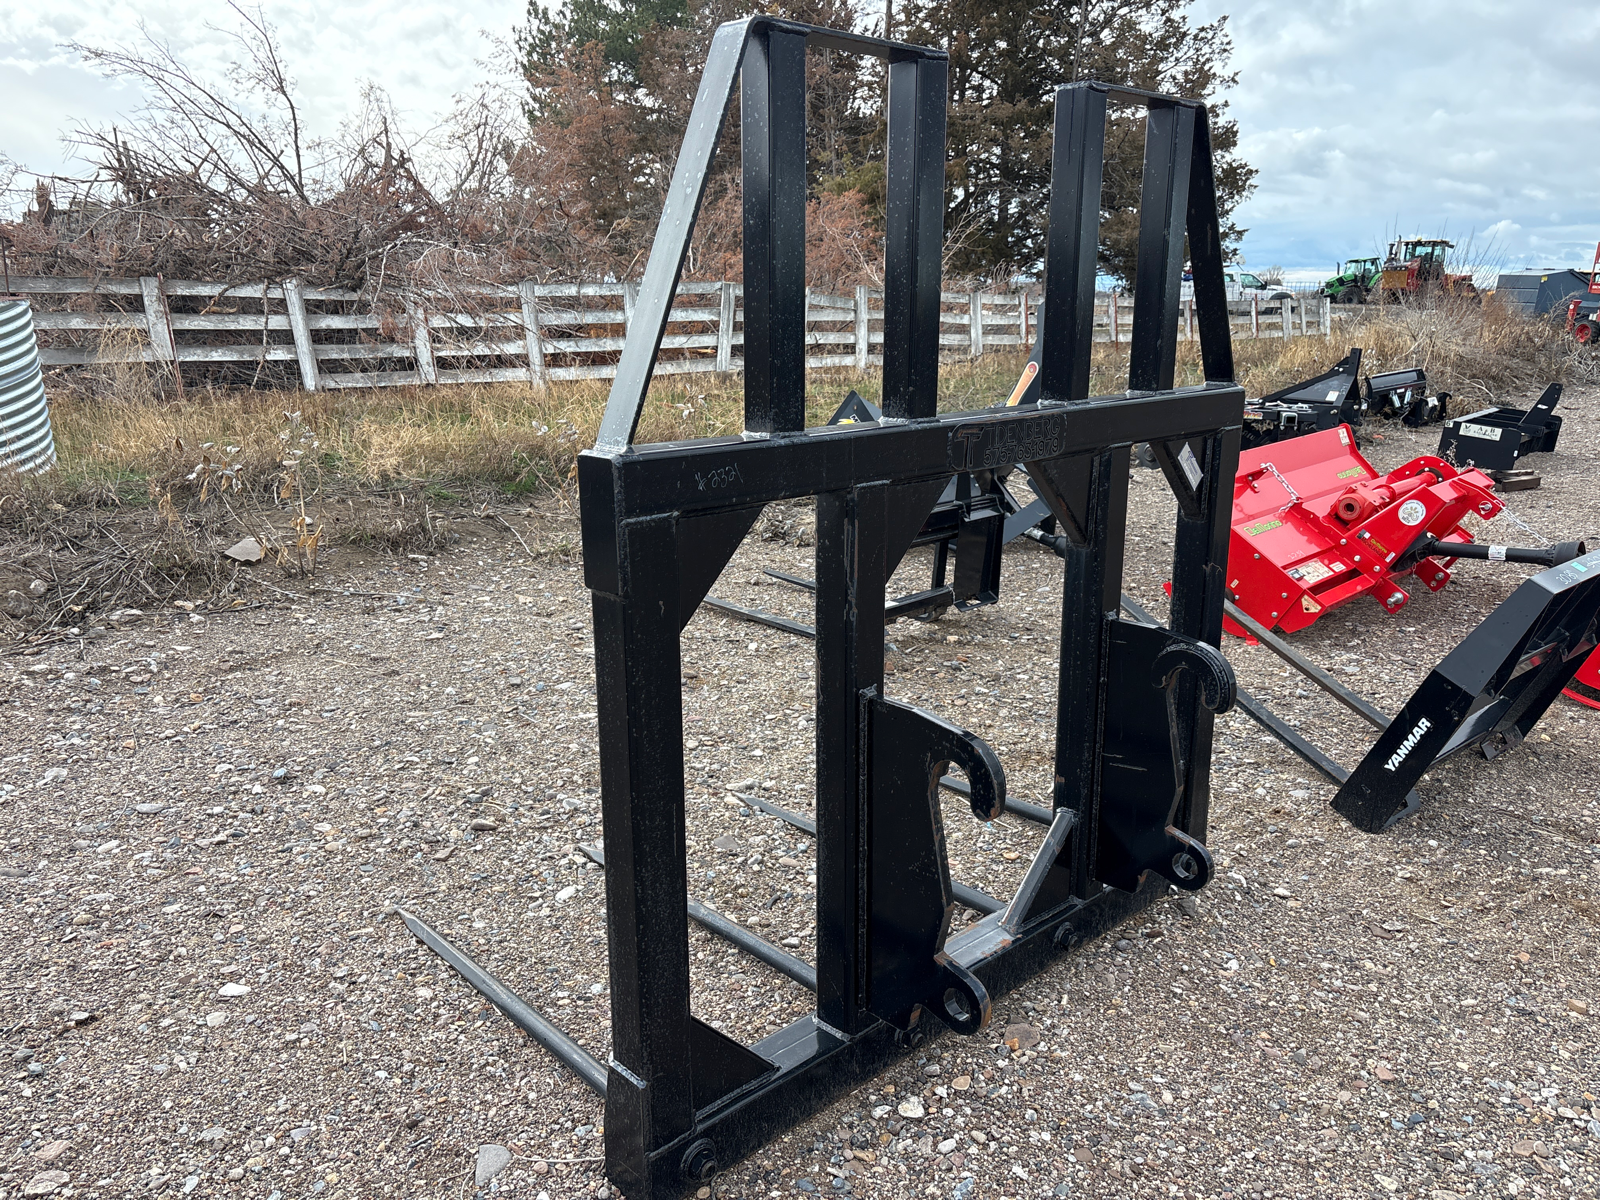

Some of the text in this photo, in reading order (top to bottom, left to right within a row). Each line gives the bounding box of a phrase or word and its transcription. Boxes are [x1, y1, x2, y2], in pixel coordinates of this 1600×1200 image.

[985, 416, 1061, 447] TIDENBERG
[983, 437, 1059, 466] 575-763-1979
[1383, 717, 1432, 772] YANMAR
